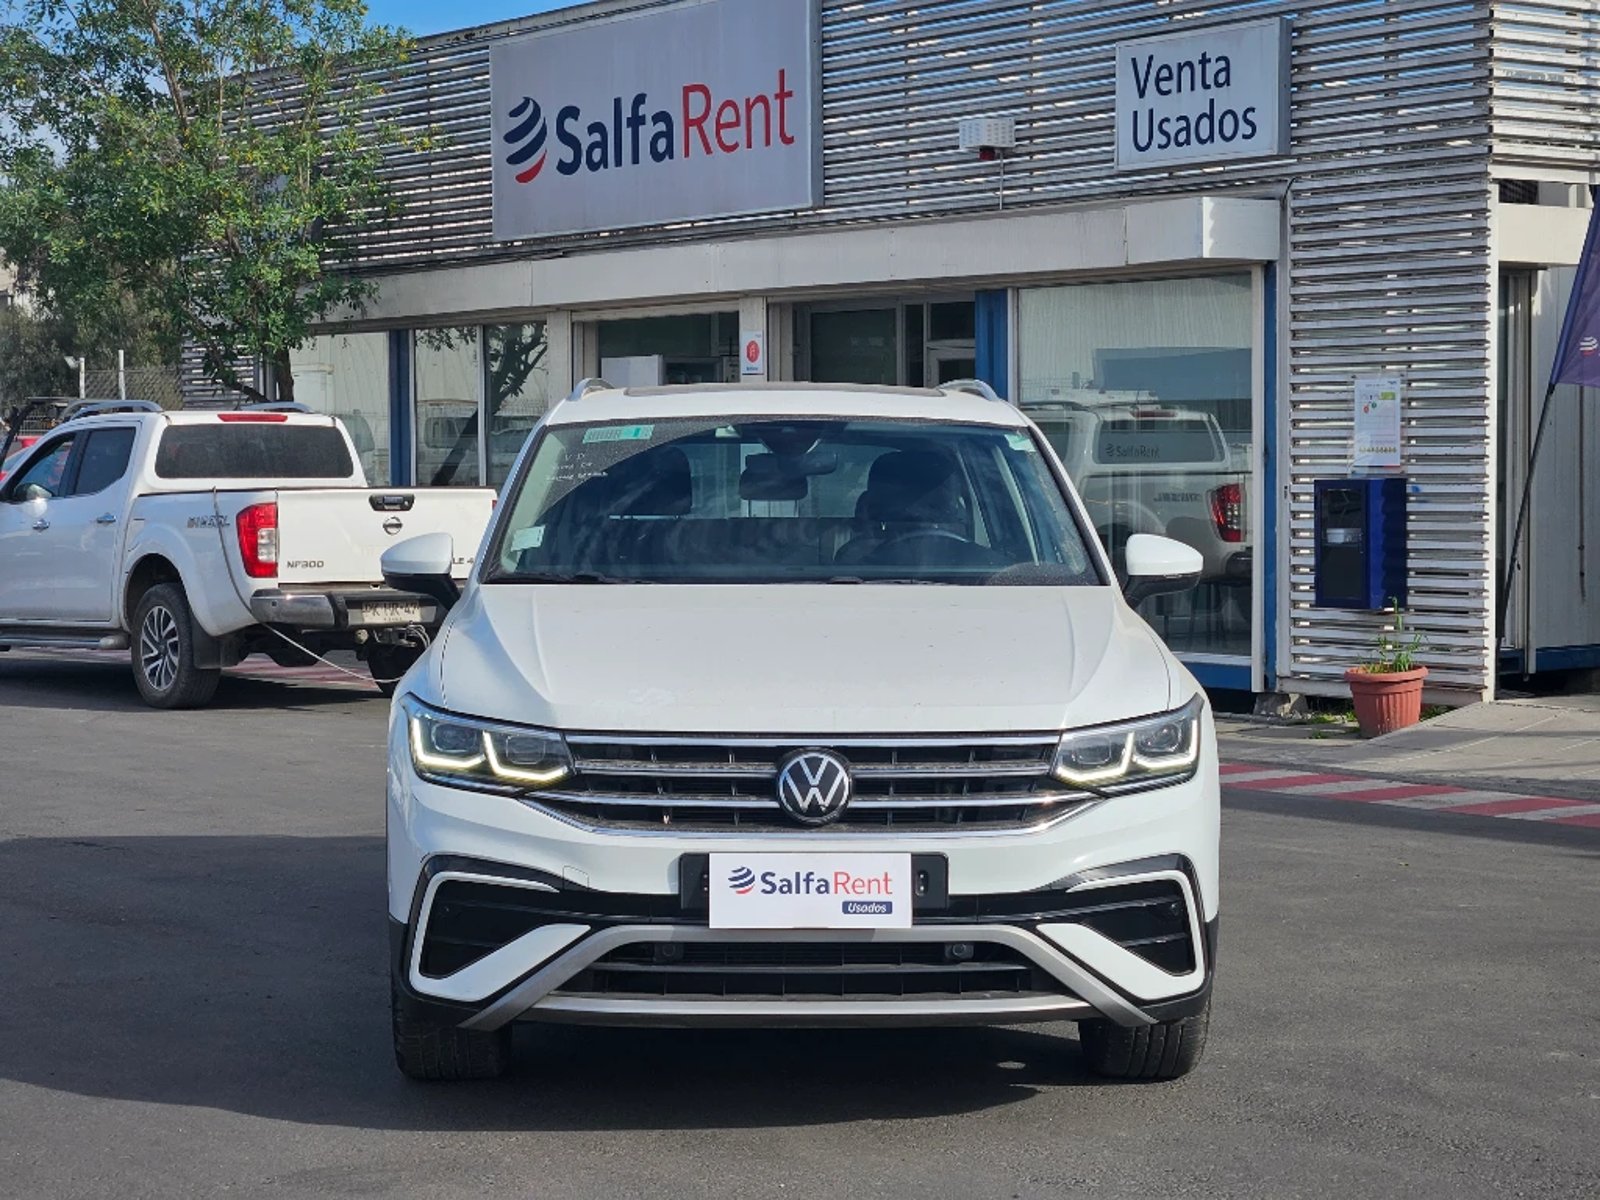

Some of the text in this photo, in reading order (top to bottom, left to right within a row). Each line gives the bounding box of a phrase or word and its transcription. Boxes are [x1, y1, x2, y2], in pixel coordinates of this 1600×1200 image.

[1131, 51, 1231, 99] Venta
[555, 68, 795, 176] SalfaRent
[1132, 98, 1257, 152] Usados
[286, 560, 325, 569] NP300
[759, 871, 893, 895] SalfaRent
[848, 902, 887, 913] Usados
